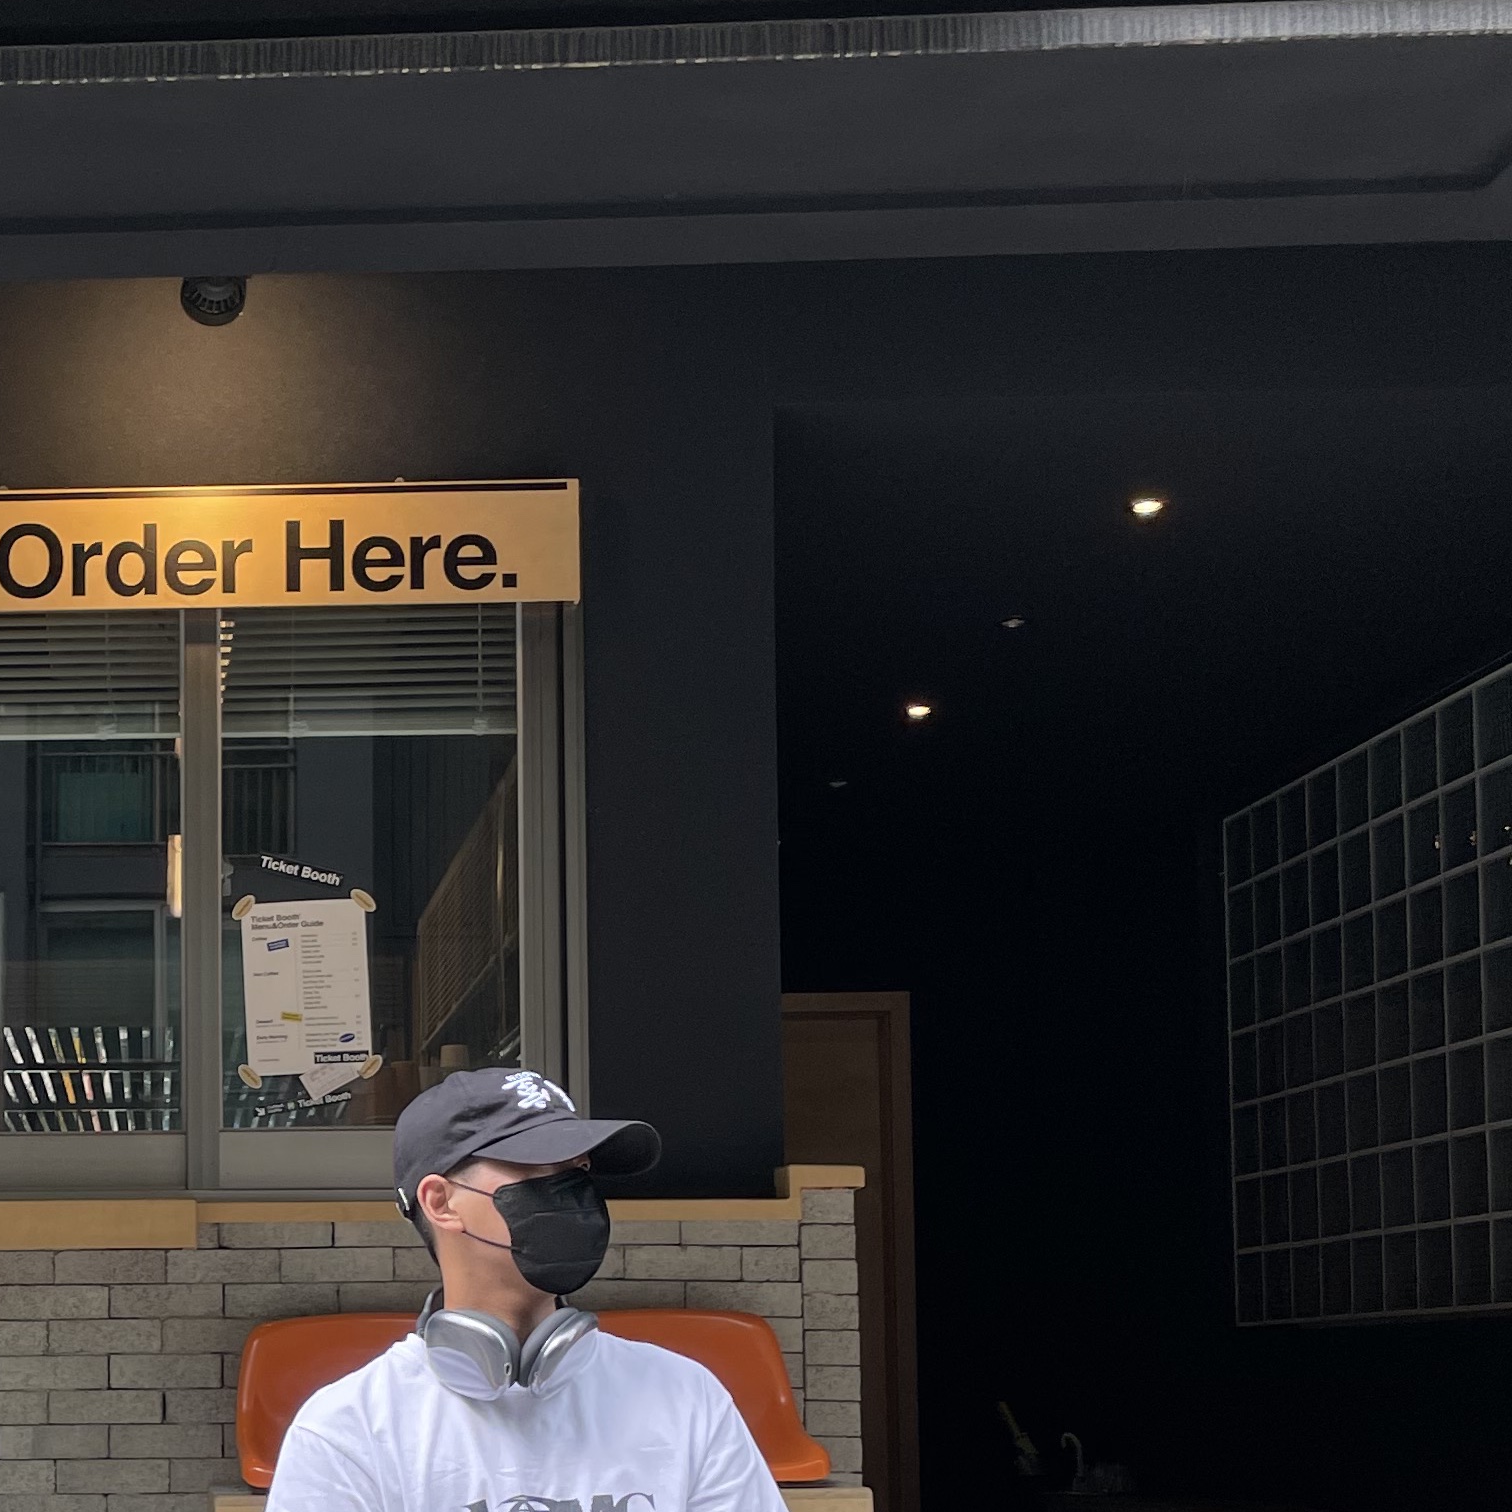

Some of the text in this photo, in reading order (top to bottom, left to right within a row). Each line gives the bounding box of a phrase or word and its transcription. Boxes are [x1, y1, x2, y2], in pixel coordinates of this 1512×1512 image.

[285, 518, 518, 593] Here.
[260, 855, 341, 887] Ticket Booth
